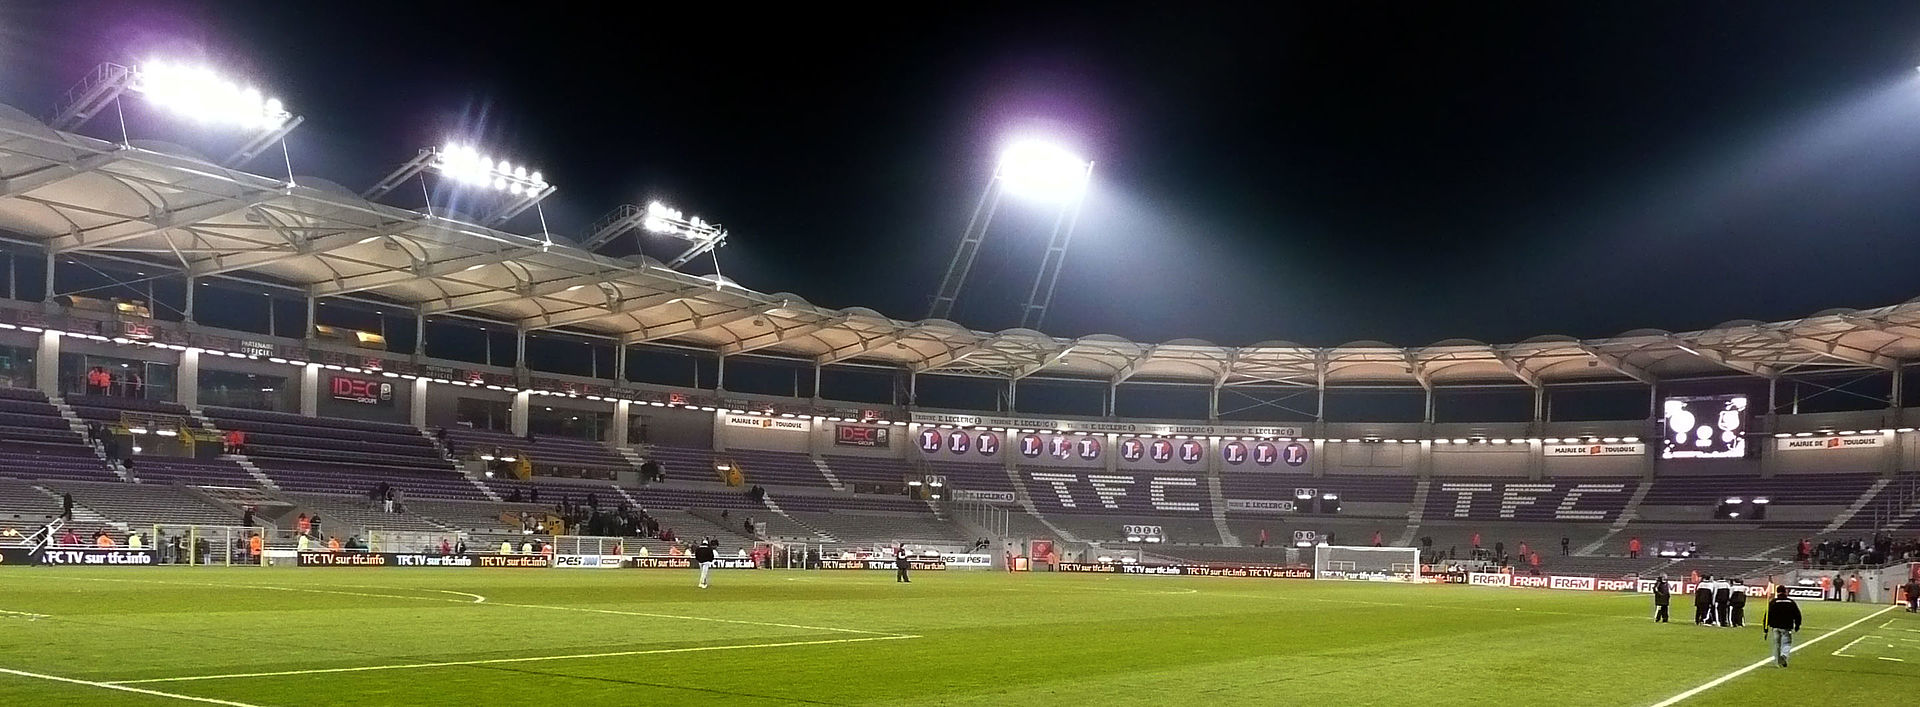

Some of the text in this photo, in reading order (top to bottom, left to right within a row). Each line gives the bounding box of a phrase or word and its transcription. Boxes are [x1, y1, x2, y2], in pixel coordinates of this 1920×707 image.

[334, 377, 377, 398] IDEC
[731, 417, 751, 425] MAIRIE
[775, 421, 802, 429] TOULOUSE
[839, 426, 875, 442] IDEC
[1031, 472, 1200, 511] TFC
[1442, 483, 1625, 519] TFC
[65, 551, 84, 563] TV
[84, 554, 106, 563] sur
[107, 551, 151, 564] tfc.info
[301, 554, 385, 565] TFC TV sur tfc.info
[396, 555, 472, 566] TFC TV sur tfc.info
[480, 556, 547, 567] TFC TV sur tfc.info
[557, 556, 582, 566] PES
[636, 559, 649, 567] TFC
[649, 559, 658, 567] TV
[1060, 563, 1072, 571] TFC
[1187, 567, 1199, 575] TFC
[1249, 569, 1262, 577] TFC
[1262, 569, 1272, 577] TV
[1473, 575, 1506, 585] FRAM
[1514, 576, 1548, 587] FRAM
[1555, 578, 1589, 588] FRAM
[1597, 580, 1633, 591] FRAM
